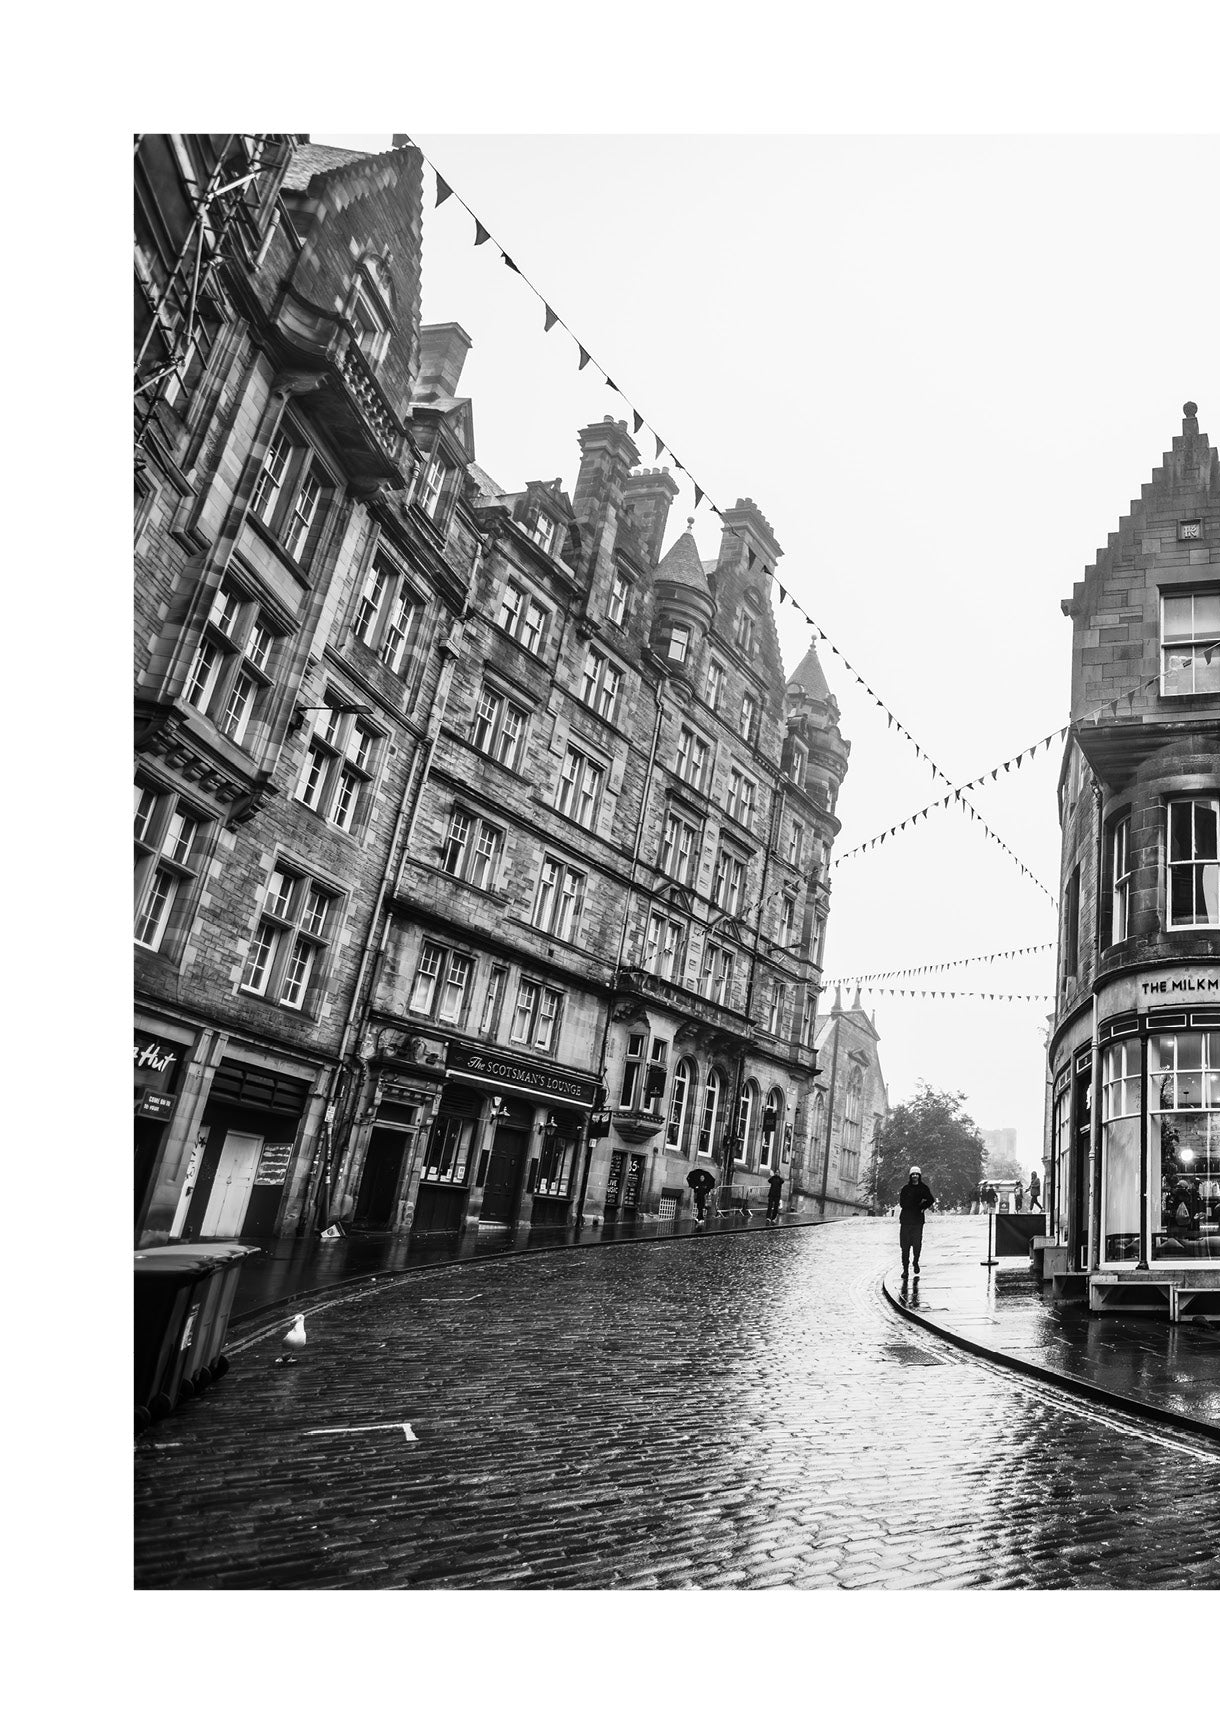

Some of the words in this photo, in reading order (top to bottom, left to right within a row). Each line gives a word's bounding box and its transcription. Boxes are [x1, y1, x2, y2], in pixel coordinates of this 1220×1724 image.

[1142, 981, 1167, 995] THE
[138, 1043, 177, 1072] Hut
[467, 1056, 486, 1071] The
[486, 1061, 546, 1086] SCOTSMAN'S
[546, 1078, 582, 1096] LOUNGE
